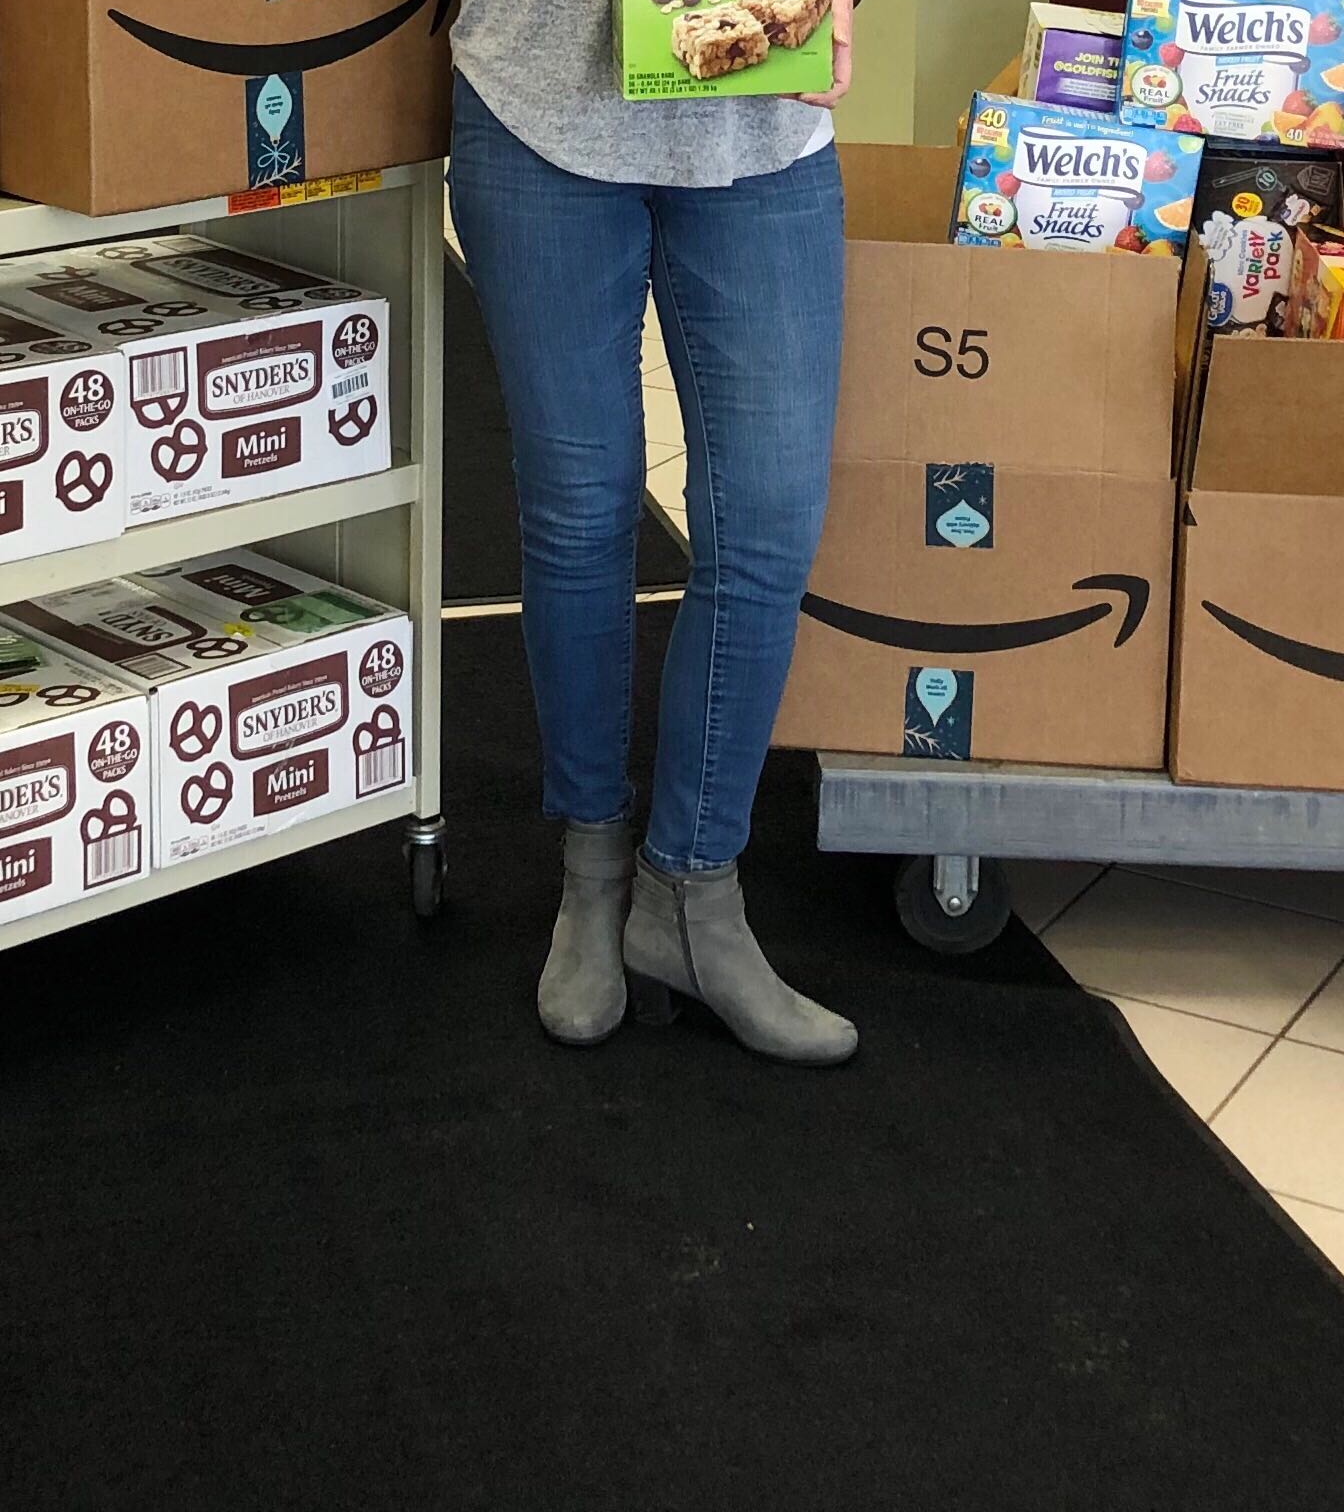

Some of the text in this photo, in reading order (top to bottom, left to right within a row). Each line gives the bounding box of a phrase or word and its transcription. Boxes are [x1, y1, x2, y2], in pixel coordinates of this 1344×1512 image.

[1185, 11, 1304, 45] Welch's
[1074, 52, 1104, 64] JOIN
[1213, 68, 1264, 88] Fruit
[1139, 87, 1170, 99] REAL
[1143, 95, 1164, 104] Fruit
[1195, 83, 1272, 105] Snacks
[979, 108, 1007, 128] 40
[1041, 115, 1064, 126] Fruit
[1285, 128, 1303, 142] 40
[1023, 141, 1140, 180] Welch's
[1258, 172, 1275, 187] 10
[1047, 201, 1099, 219] Fruit
[1235, 196, 1250, 211] 30
[974, 215, 1004, 227] REAL
[978, 222, 998, 232] Fruit
[1029, 214, 1105, 238] Snacks
[338, 318, 371, 345] 48
[334, 342, 376, 358] ON-THE-GO
[914, 326, 990, 379] S5
[211, 357, 310, 399] SNYDER'S
[68, 373, 105, 404] 48
[233, 384, 290, 405] OF HANOVER
[63, 399, 112, 417] ON-THE-GO
[74, 415, 100, 428] PACKS
[235, 426, 287, 459] Mini
[243, 453, 278, 469] Pretzels
[365, 643, 396, 673] 48
[361, 666, 402, 687] ON-THE-GO
[371, 682, 392, 695] PACKS
[243, 689, 337, 739] SNYDER'S
[95, 724, 131, 756] 48
[262, 717, 318, 743] OF HANOVER
[90, 748, 138, 771] ON-THE-GO
[102, 765, 127, 780] PACKS
[267, 759, 315, 795] Mini
[274, 786, 307, 804] Pretzels
